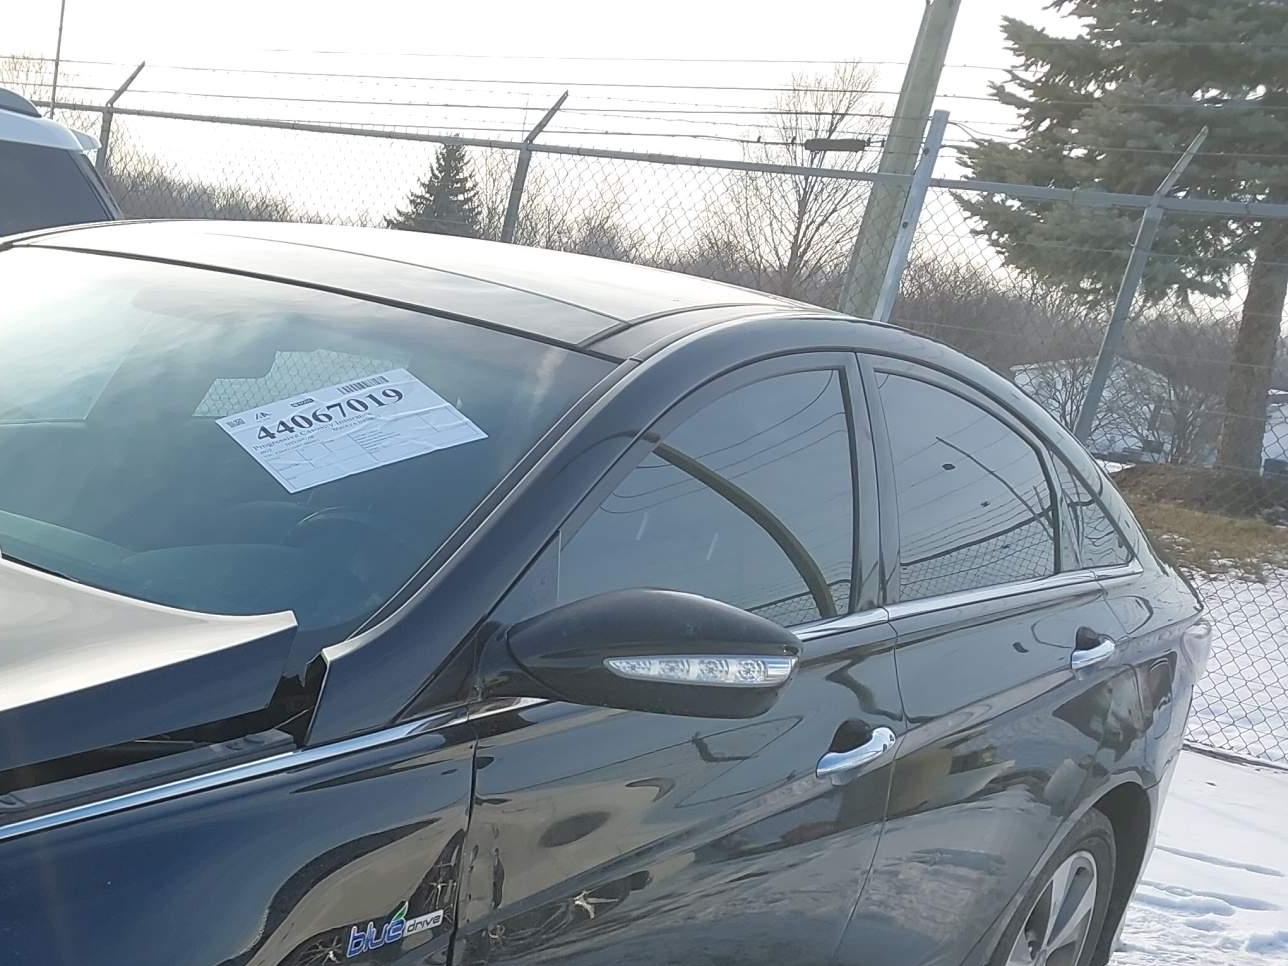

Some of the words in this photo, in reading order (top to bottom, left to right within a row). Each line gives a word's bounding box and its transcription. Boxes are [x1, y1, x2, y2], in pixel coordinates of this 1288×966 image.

[257, 388, 404, 440] 44067019
[347, 918, 406, 958] blue
[407, 915, 441, 933] drive
